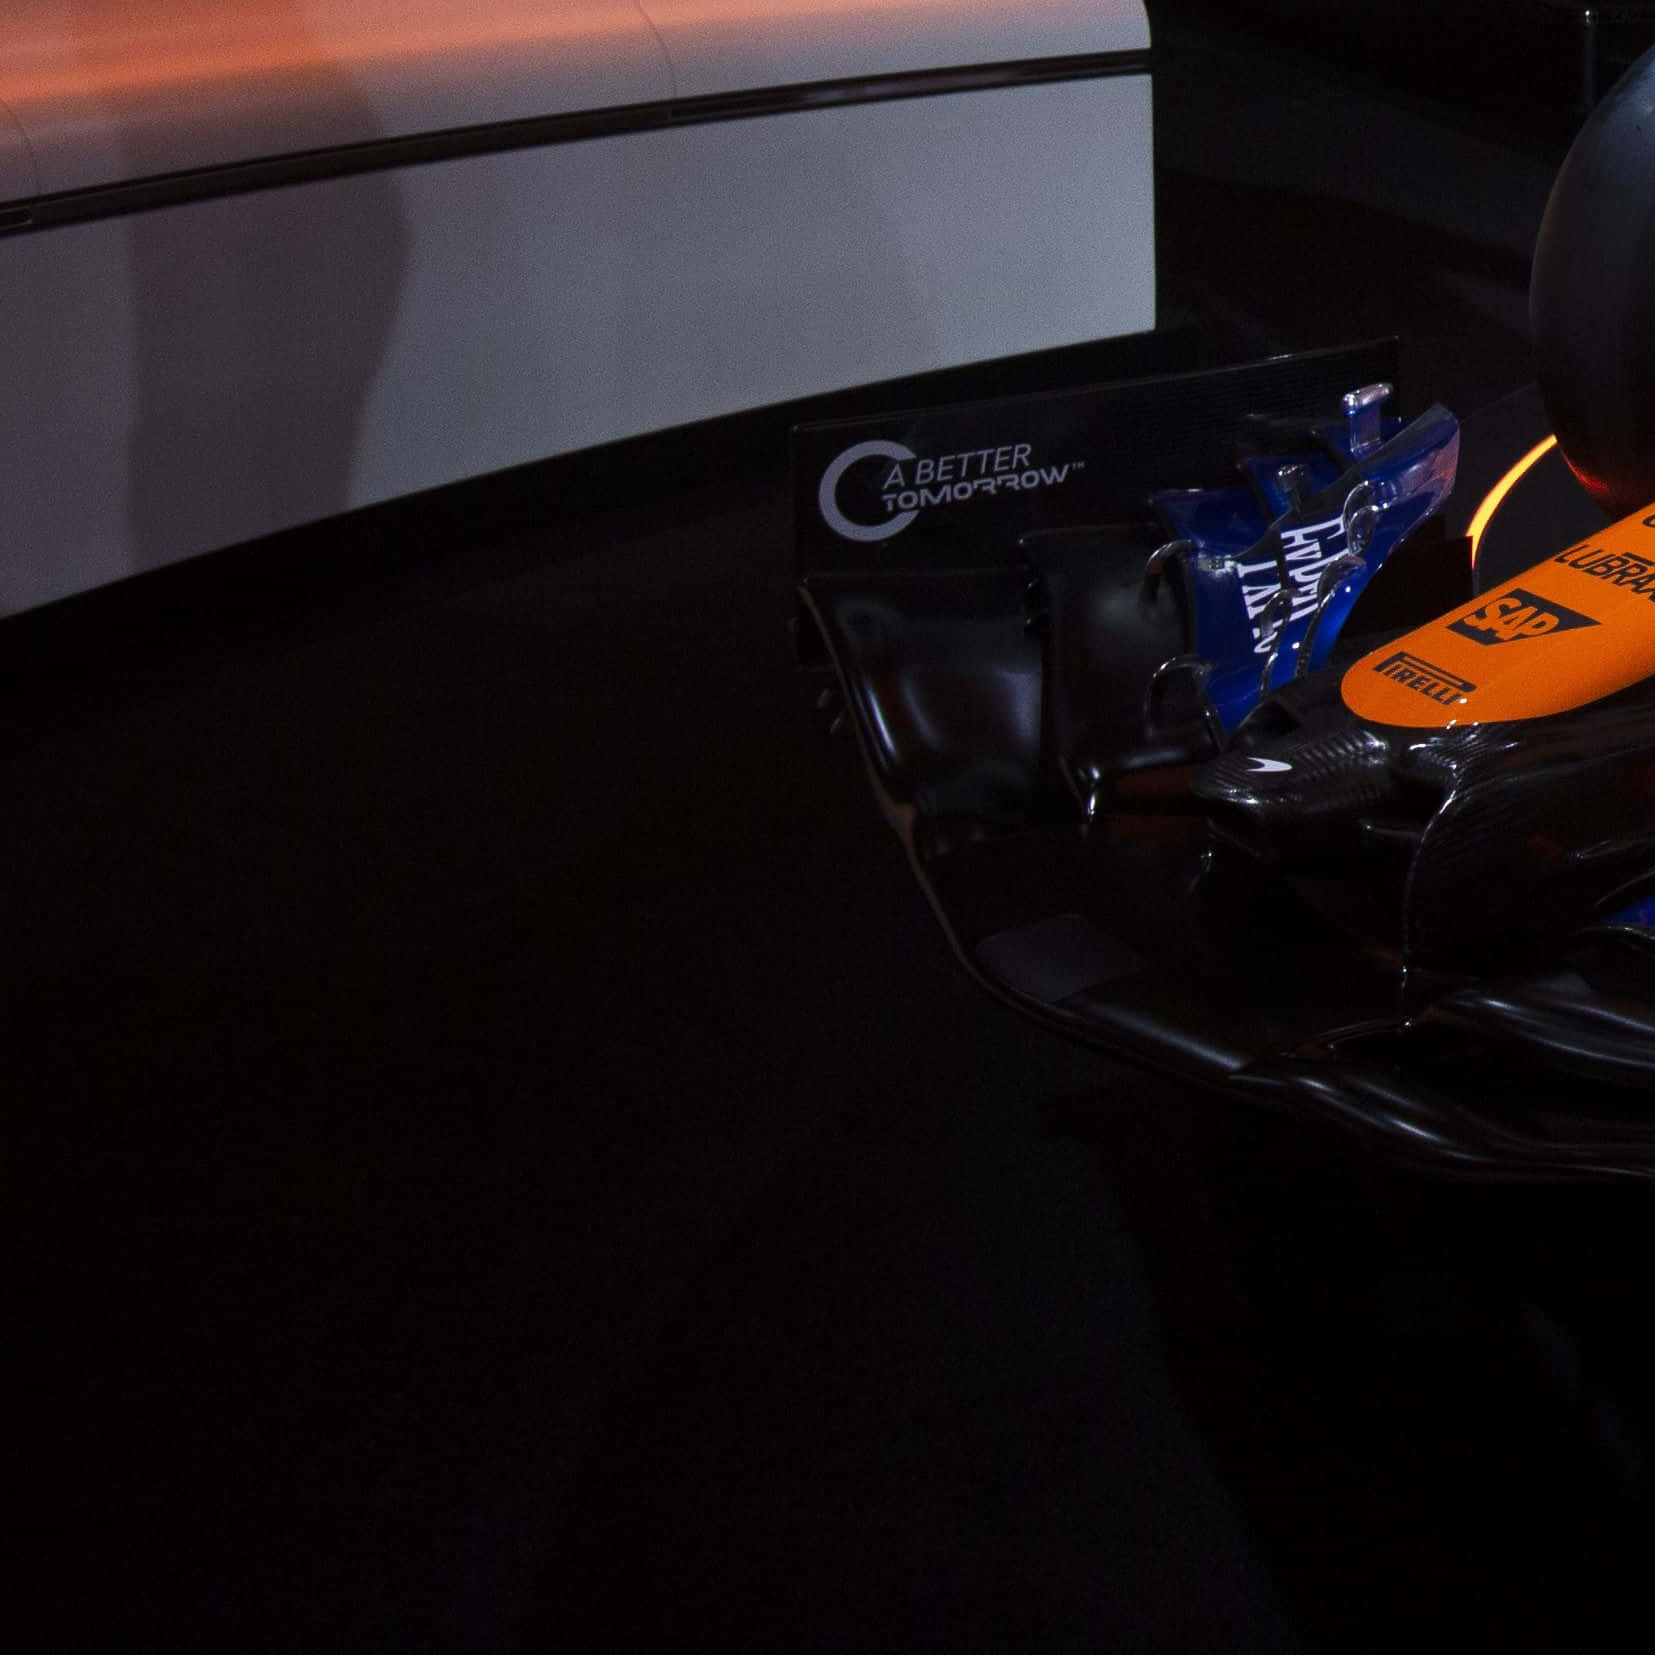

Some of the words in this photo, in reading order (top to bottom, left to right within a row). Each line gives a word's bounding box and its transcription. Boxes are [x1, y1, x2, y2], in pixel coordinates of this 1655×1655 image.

[882, 463, 906, 490] A
[914, 443, 1032, 486] BETTER
[1371, 650, 1478, 706] PIRELLI
